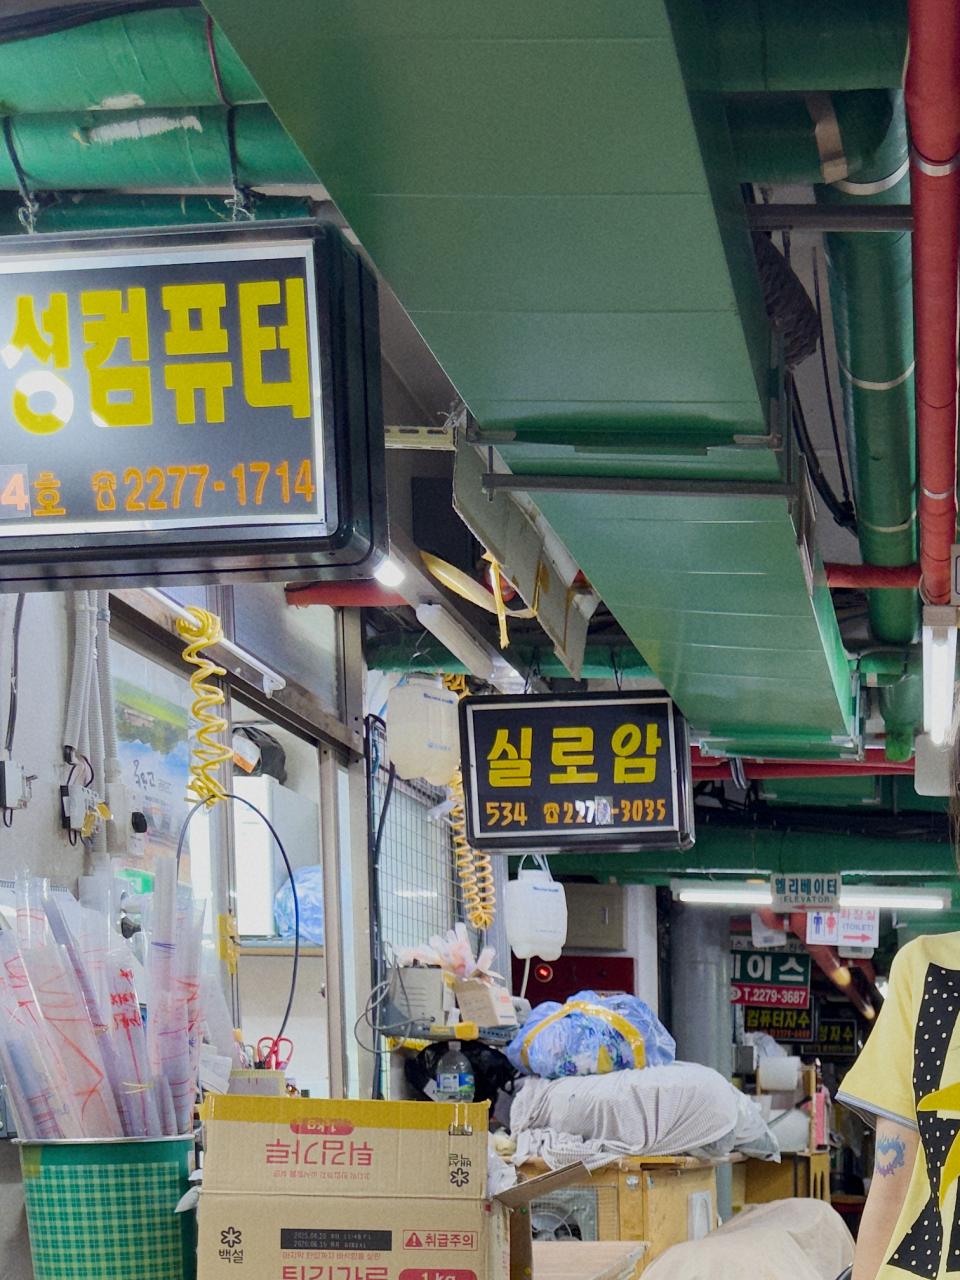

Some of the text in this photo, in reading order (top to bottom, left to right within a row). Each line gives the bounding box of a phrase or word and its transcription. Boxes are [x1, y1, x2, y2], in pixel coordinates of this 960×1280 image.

[486, 723, 662, 787] 실로암
[486, 801, 528, 827] 534
[265, 1138, 375, 1167] 튀김가루
[424, 1233, 475, 1249] 취급주의
[218, 1249, 245, 1264] 백설
